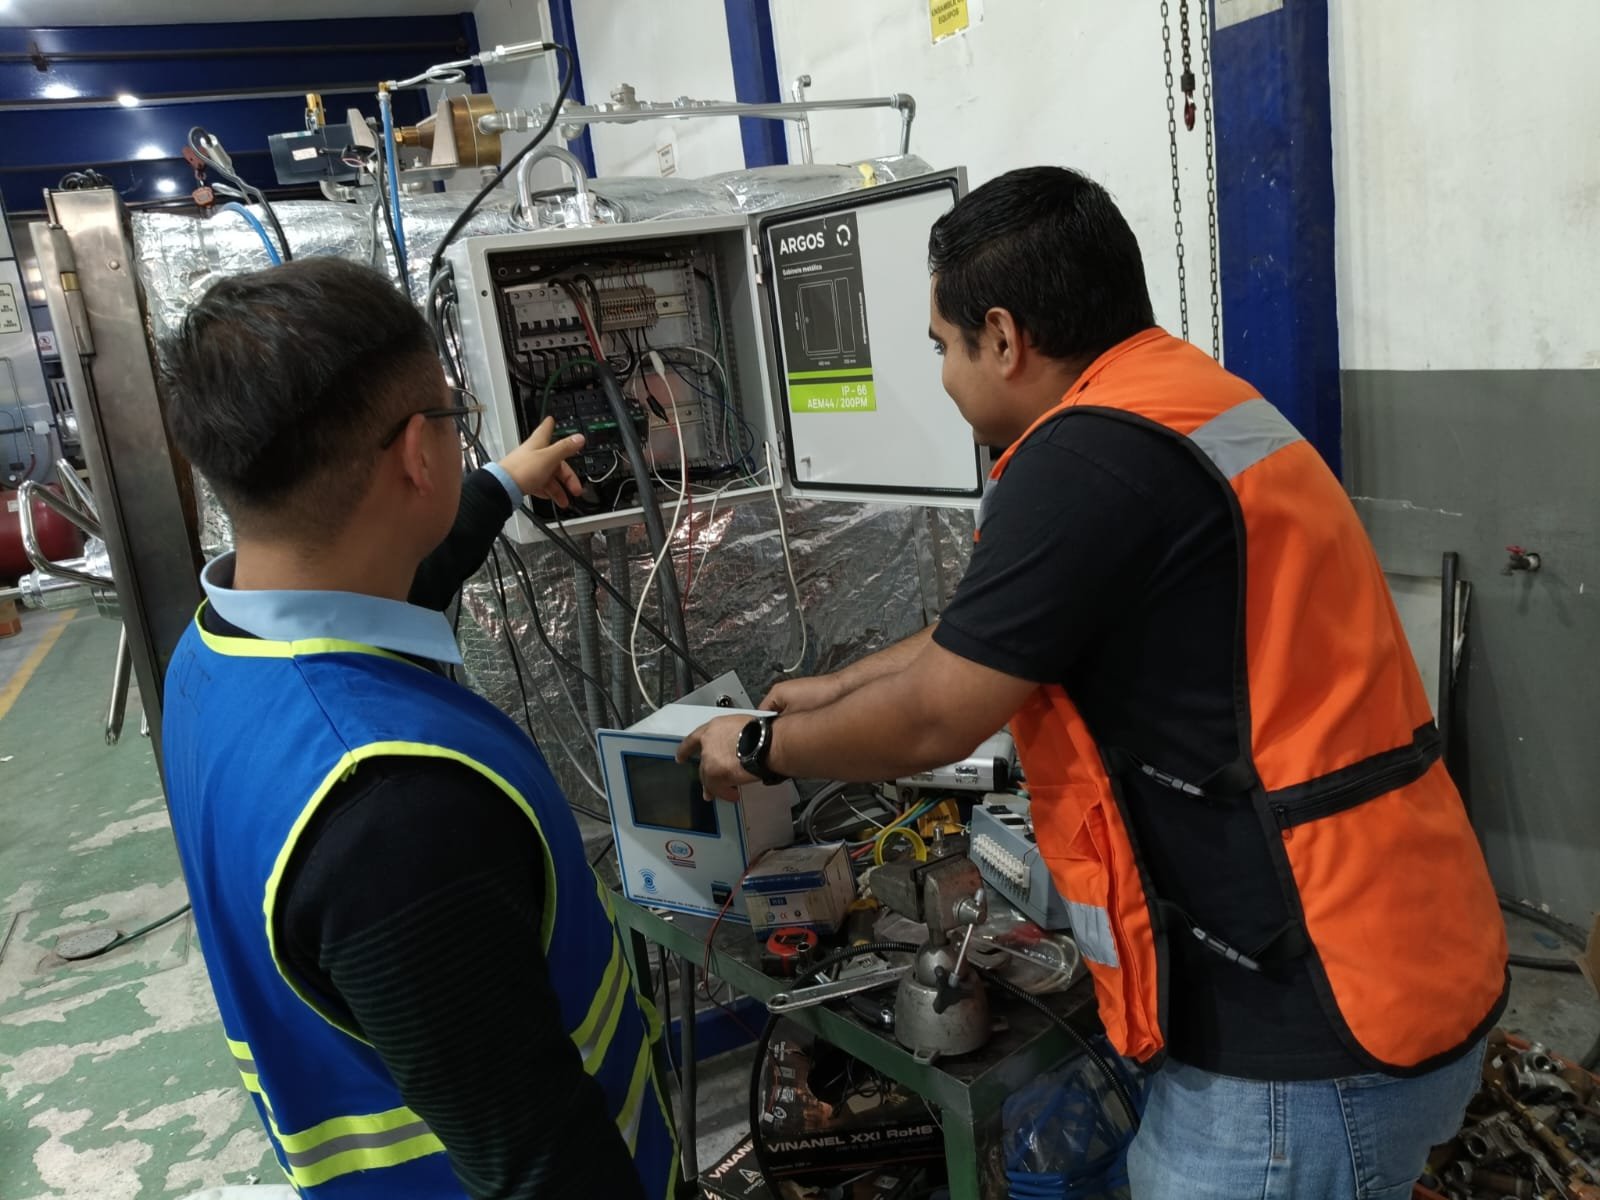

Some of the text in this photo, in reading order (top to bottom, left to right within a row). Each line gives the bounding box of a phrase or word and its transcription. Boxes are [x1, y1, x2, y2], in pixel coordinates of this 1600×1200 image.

[779, 232, 825, 255] ARGOS
[841, 385, 850, 396] IP
[856, 384, 868, 396] 66
[840, 396, 868, 408] 200PM
[768, 1136, 845, 1152] VINANEL
[850, 1132, 881, 1143] XXI
